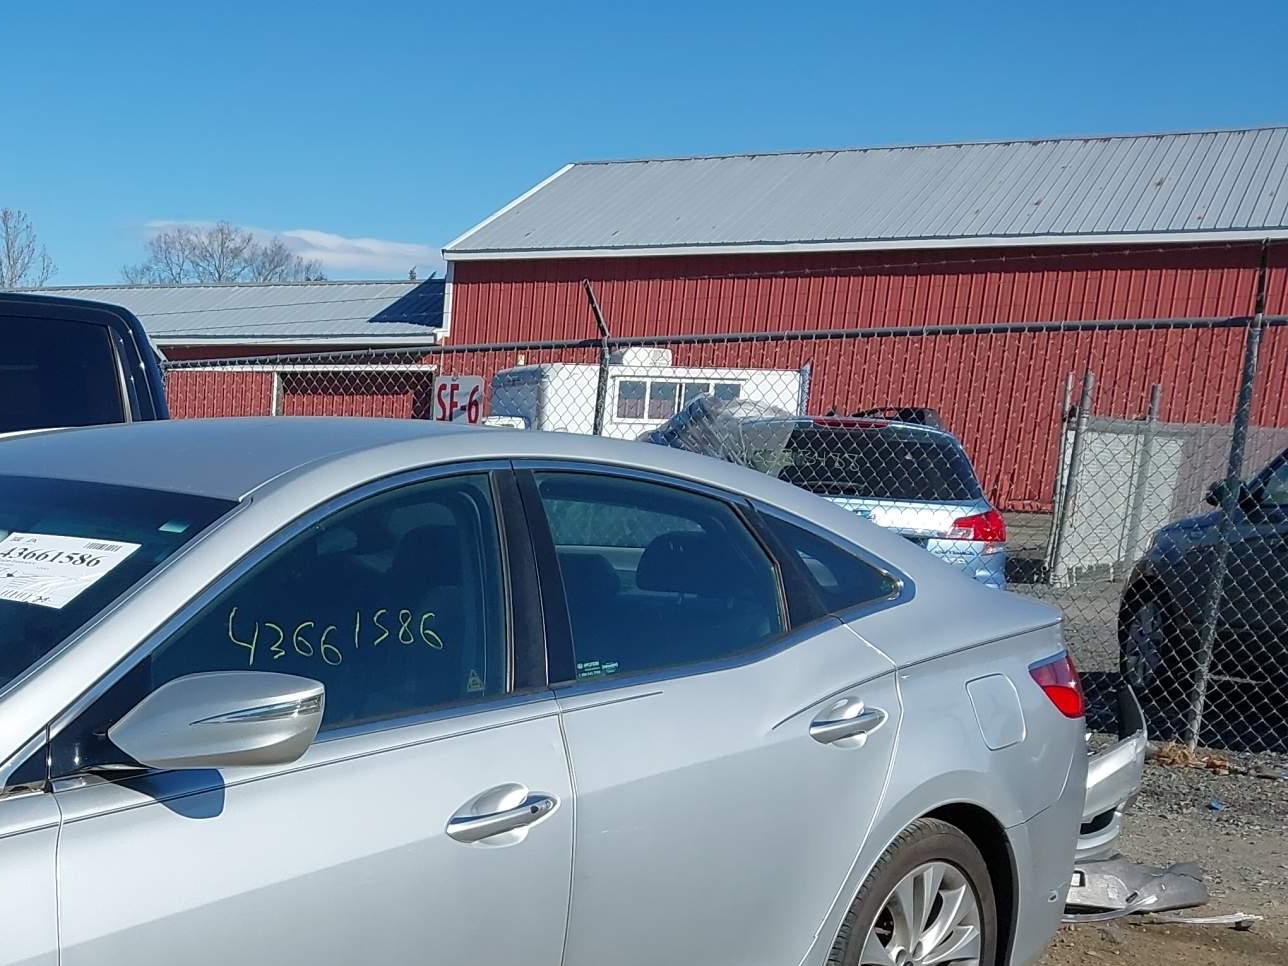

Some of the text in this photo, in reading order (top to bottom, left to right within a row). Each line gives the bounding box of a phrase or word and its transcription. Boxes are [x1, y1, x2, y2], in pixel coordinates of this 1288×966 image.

[435, 383, 480, 424] SF-6
[0, 546, 108, 568] 43661586
[227, 606, 444, 666] 43661586
